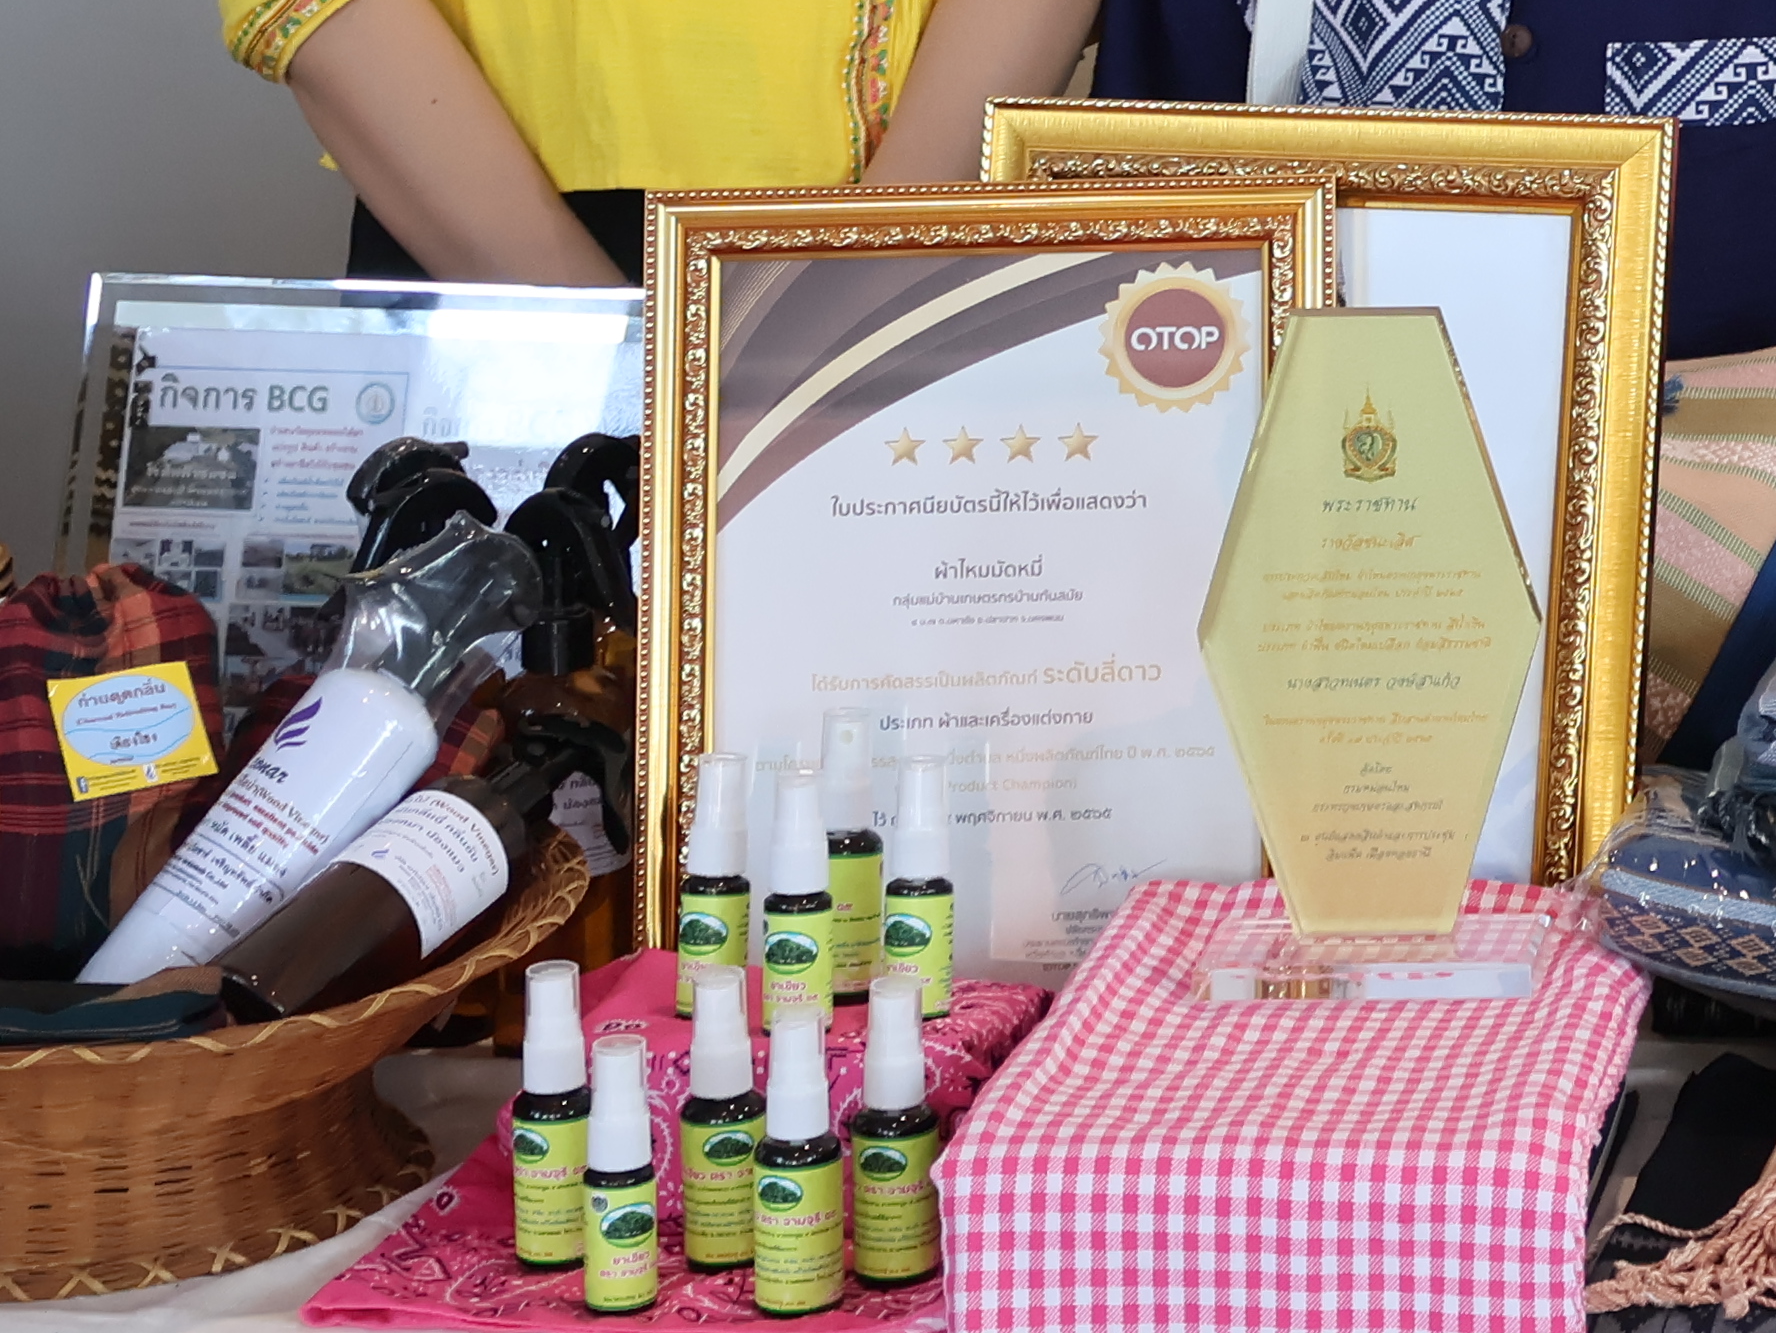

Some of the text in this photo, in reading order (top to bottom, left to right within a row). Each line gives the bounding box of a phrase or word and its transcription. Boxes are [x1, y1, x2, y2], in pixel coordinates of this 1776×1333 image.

[1131, 325, 1220, 351] OTOP
[160, 373, 330, 413] กิจการ BCG
[831, 487, 1148, 517] ใบประกาศนียบัตรนี้ให้ไว้เพื่อแสดงว่า
[934, 554, 1044, 580] ผ้าไหมมัดหมี่
[1043, 653, 1162, 684] ระดับสี่ดาว
[938, 706, 1093, 729] ผ้าและเครื่องแต่งกาย
